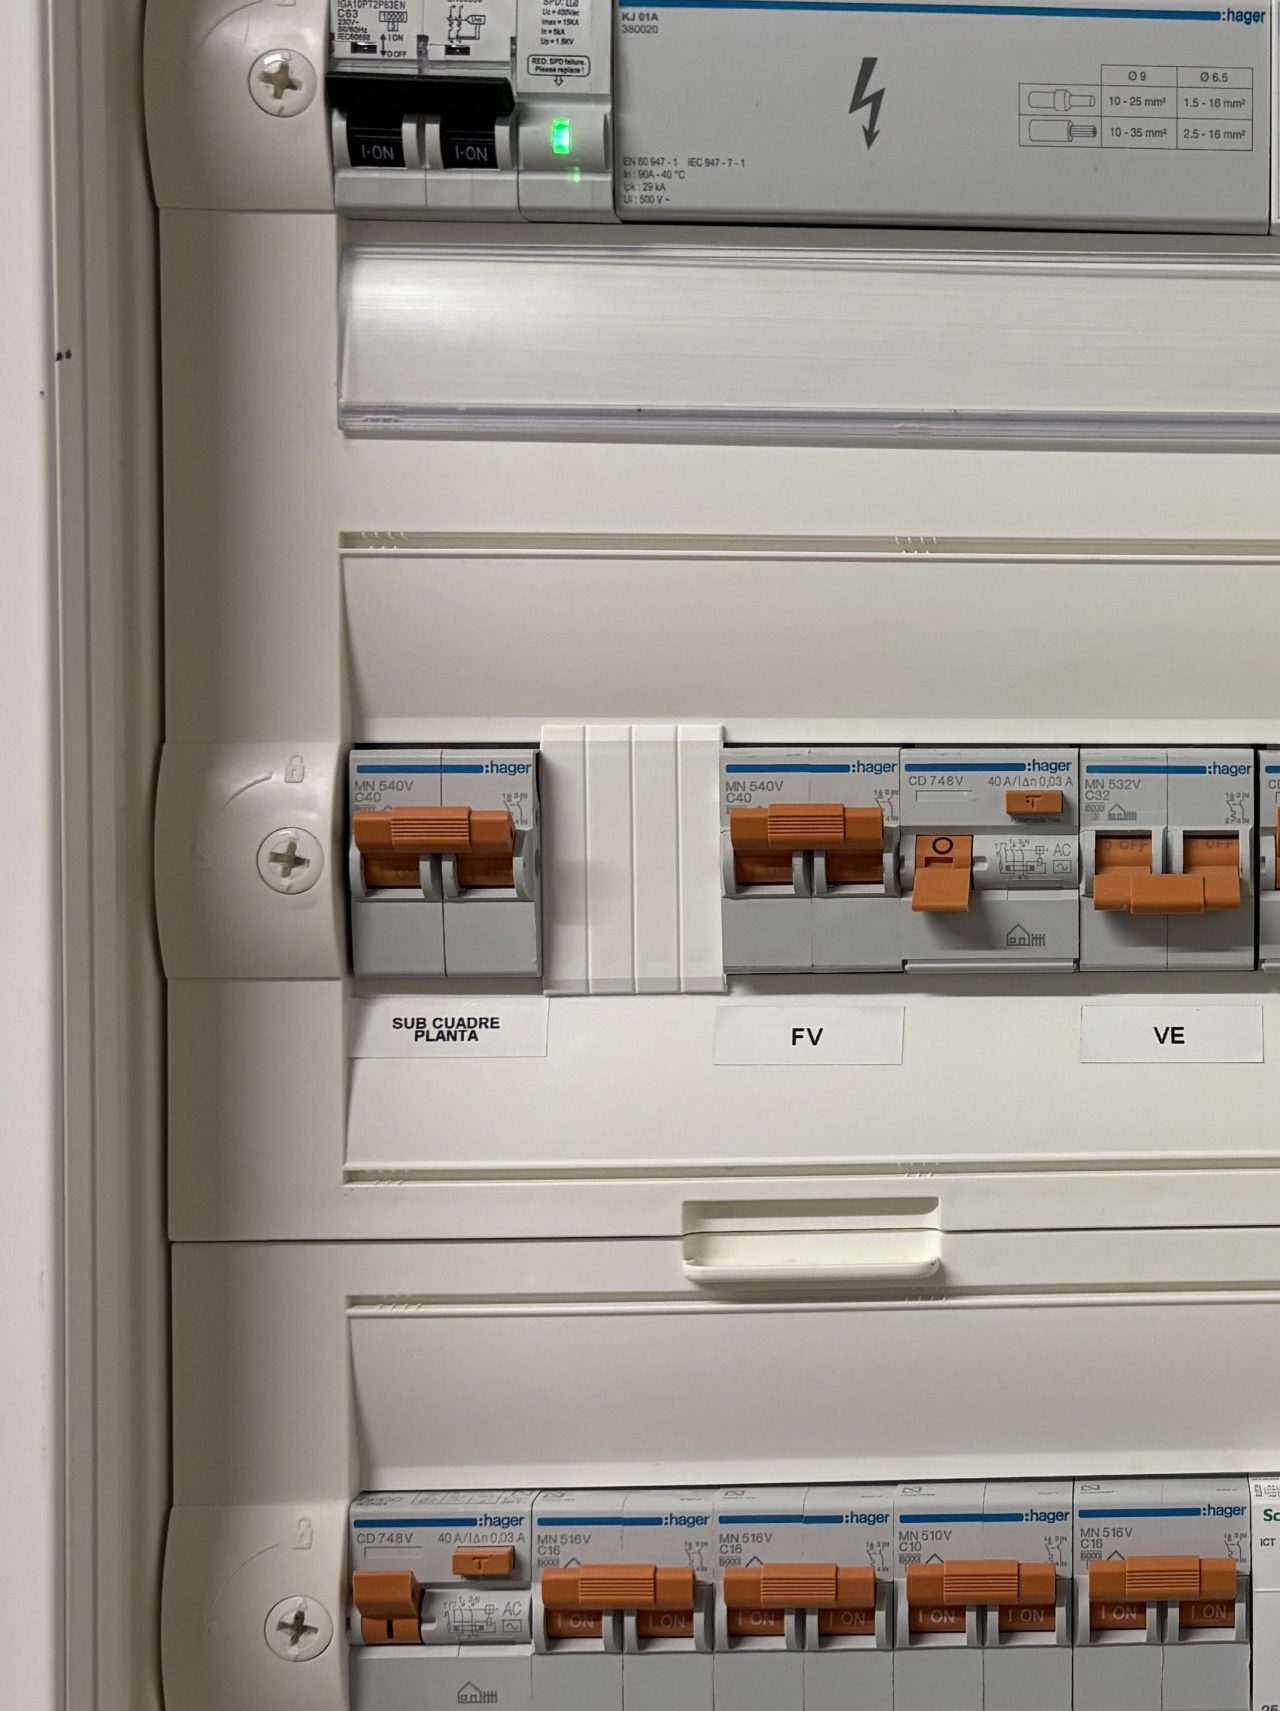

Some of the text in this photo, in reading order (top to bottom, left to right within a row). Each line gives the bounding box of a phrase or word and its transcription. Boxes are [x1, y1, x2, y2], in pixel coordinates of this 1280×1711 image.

[337, 9, 358, 18] C63
[622, 12, 658, 22] KJ 01A
[622, 25, 658, 34] 380020
[1140, 72, 1146, 81] 9
[1212, 72, 1228, 82] 6.5
[1110, 96, 1120, 106] 10
[1130, 96, 1142, 106] 25
[1185, 98, 1200, 108] 1.5
[1210, 98, 1220, 108] 16
[1110, 128, 1122, 137] 10
[1130, 128, 1143, 138] 35
[1184, 129, 1200, 138] 2.5
[1210, 130, 1220, 139] 16
[624, 157, 636, 166] EN
[650, 158, 665, 166] 947
[688, 158, 703, 167] IEC
[642, 183, 666, 192] 29 kA
[354, 780, 414, 791] MN 540V
[908, 776, 964, 786] CD 748V
[988, 776, 1002, 787] 40
[1064, 776, 1074, 787] A
[1085, 780, 1141, 790] MN 532V
[726, 781, 784, 792] MN 540V
[355, 792, 382, 802] C40
[726, 792, 752, 803] C40
[1085, 790, 1110, 800] C32
[1054, 843, 1071, 856] AC
[392, 1017, 500, 1029] SUB CUADRE
[414, 1030, 478, 1042] PLANTA
[792, 1028, 824, 1046] FV
[1154, 1027, 1184, 1044] VE
[438, 1532, 452, 1544] 40
[516, 1532, 526, 1544] A
[899, 1530, 952, 1541] MN 510V
[1080, 1528, 1132, 1538] MN 516V
[357, 1533, 413, 1544] CD 748V
[538, 1534, 592, 1544] MN 516V
[1080, 1538, 1102, 1549] C16
[1260, 1538, 1276, 1547] ICT
[538, 1546, 560, 1556] C16
[899, 1542, 922, 1552] C10
[930, 1610, 955, 1624] ON
